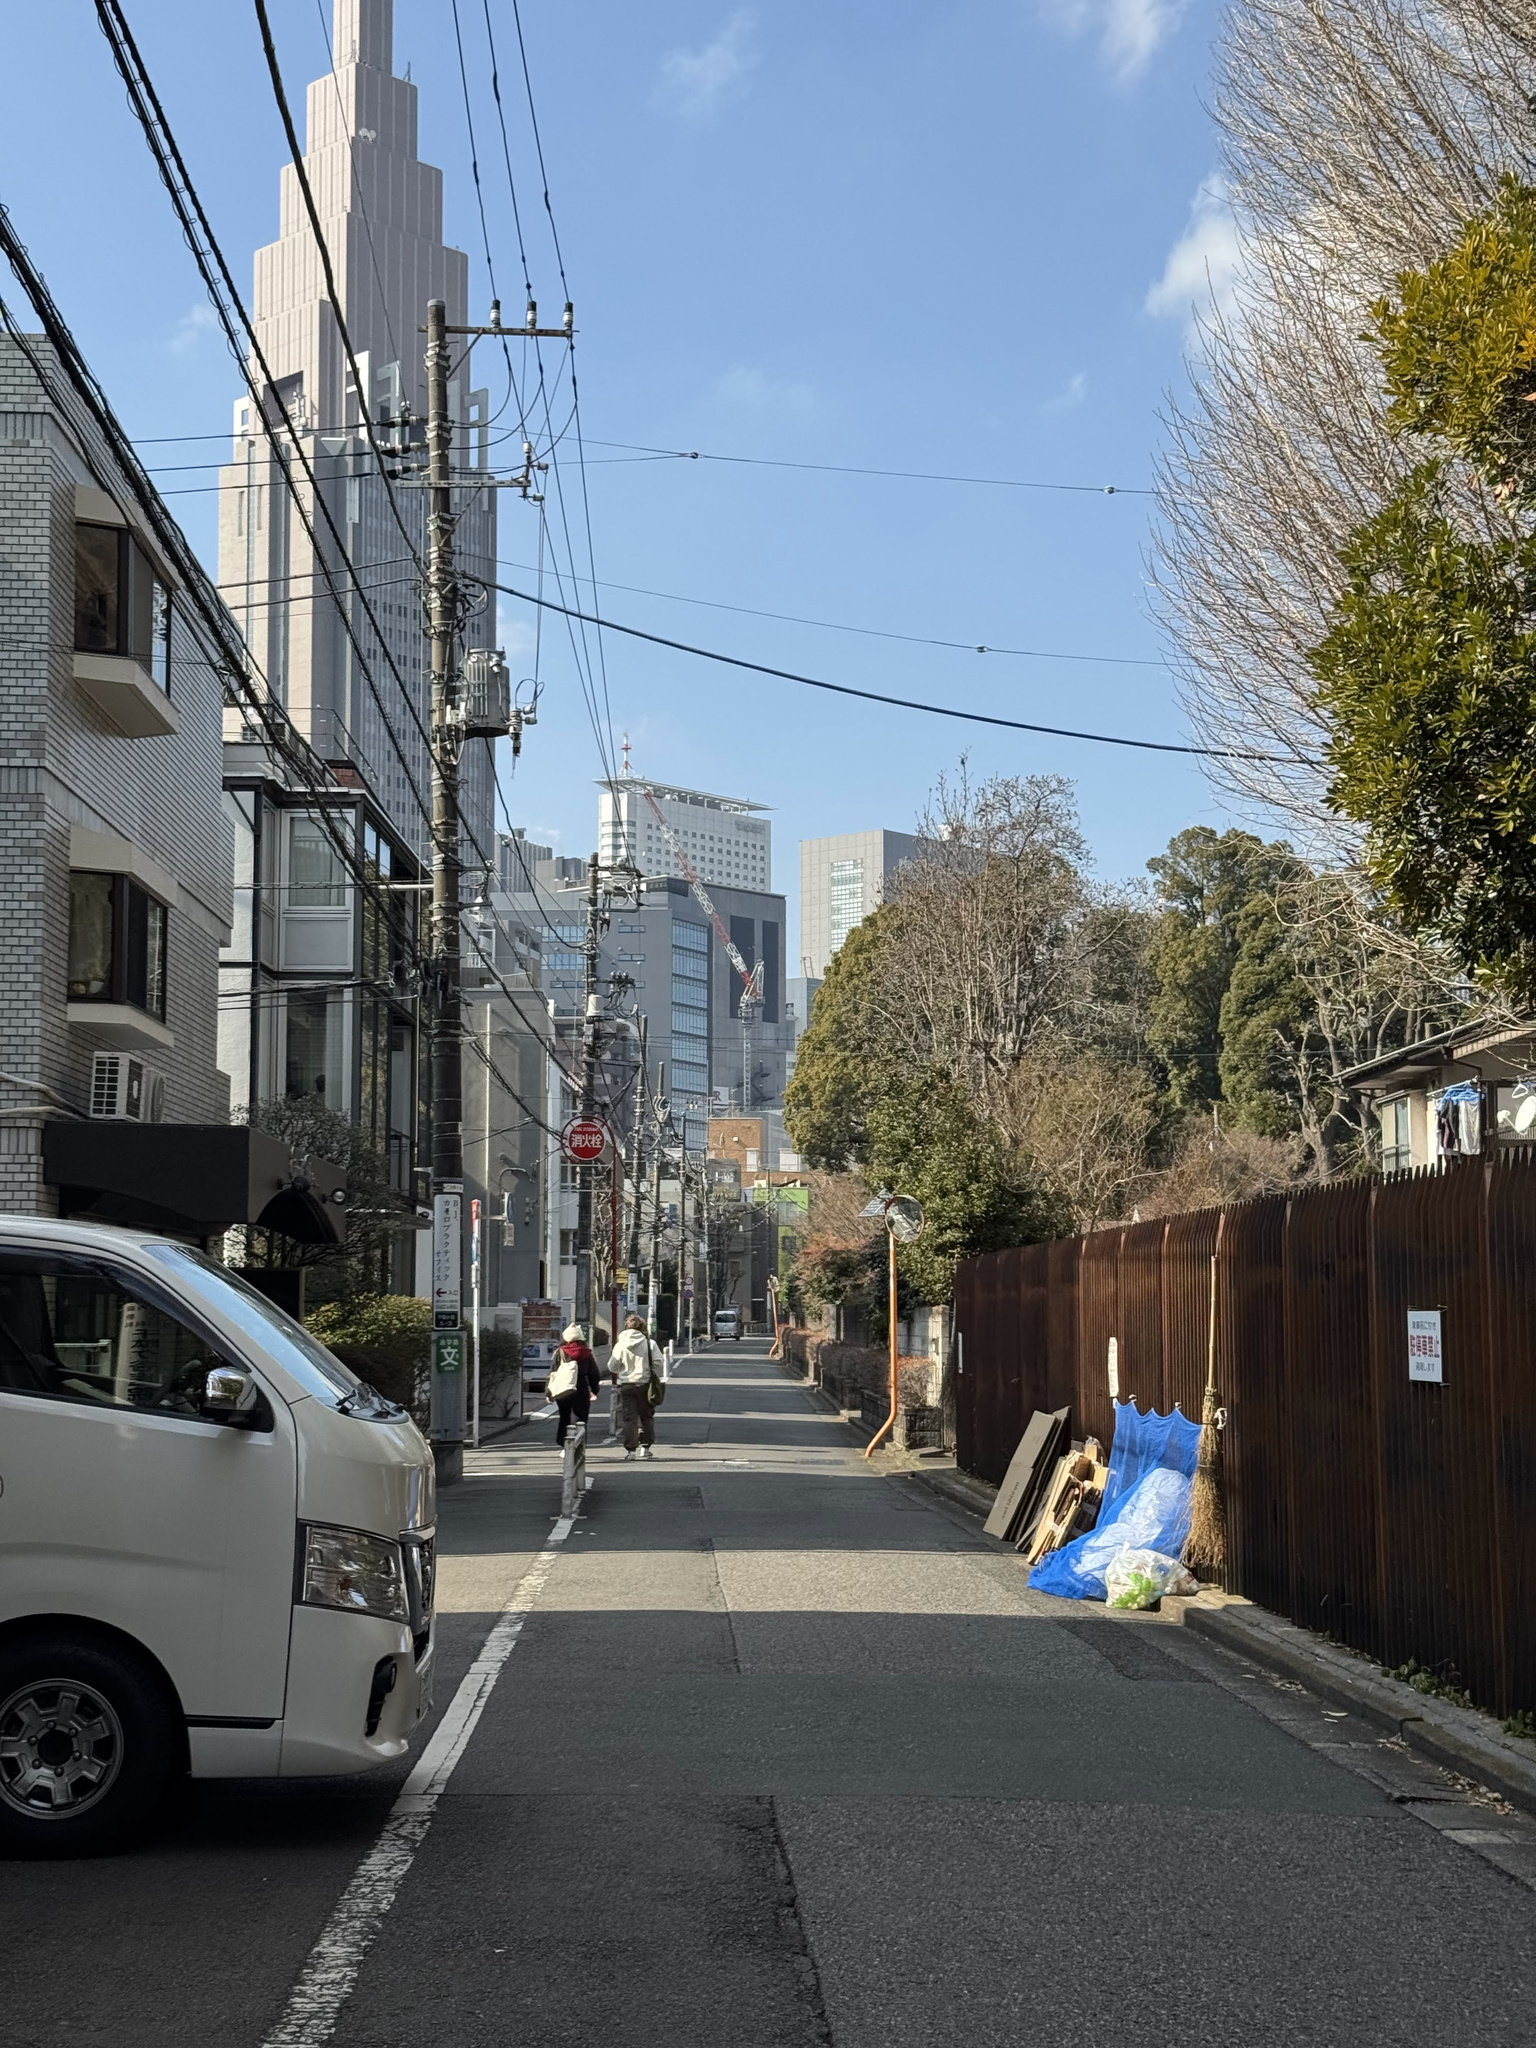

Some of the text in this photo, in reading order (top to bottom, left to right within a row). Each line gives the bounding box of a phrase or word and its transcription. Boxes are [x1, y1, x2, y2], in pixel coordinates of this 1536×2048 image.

[571, 1133, 603, 1148] 消火栓
[440, 1346, 459, 1366] 文
